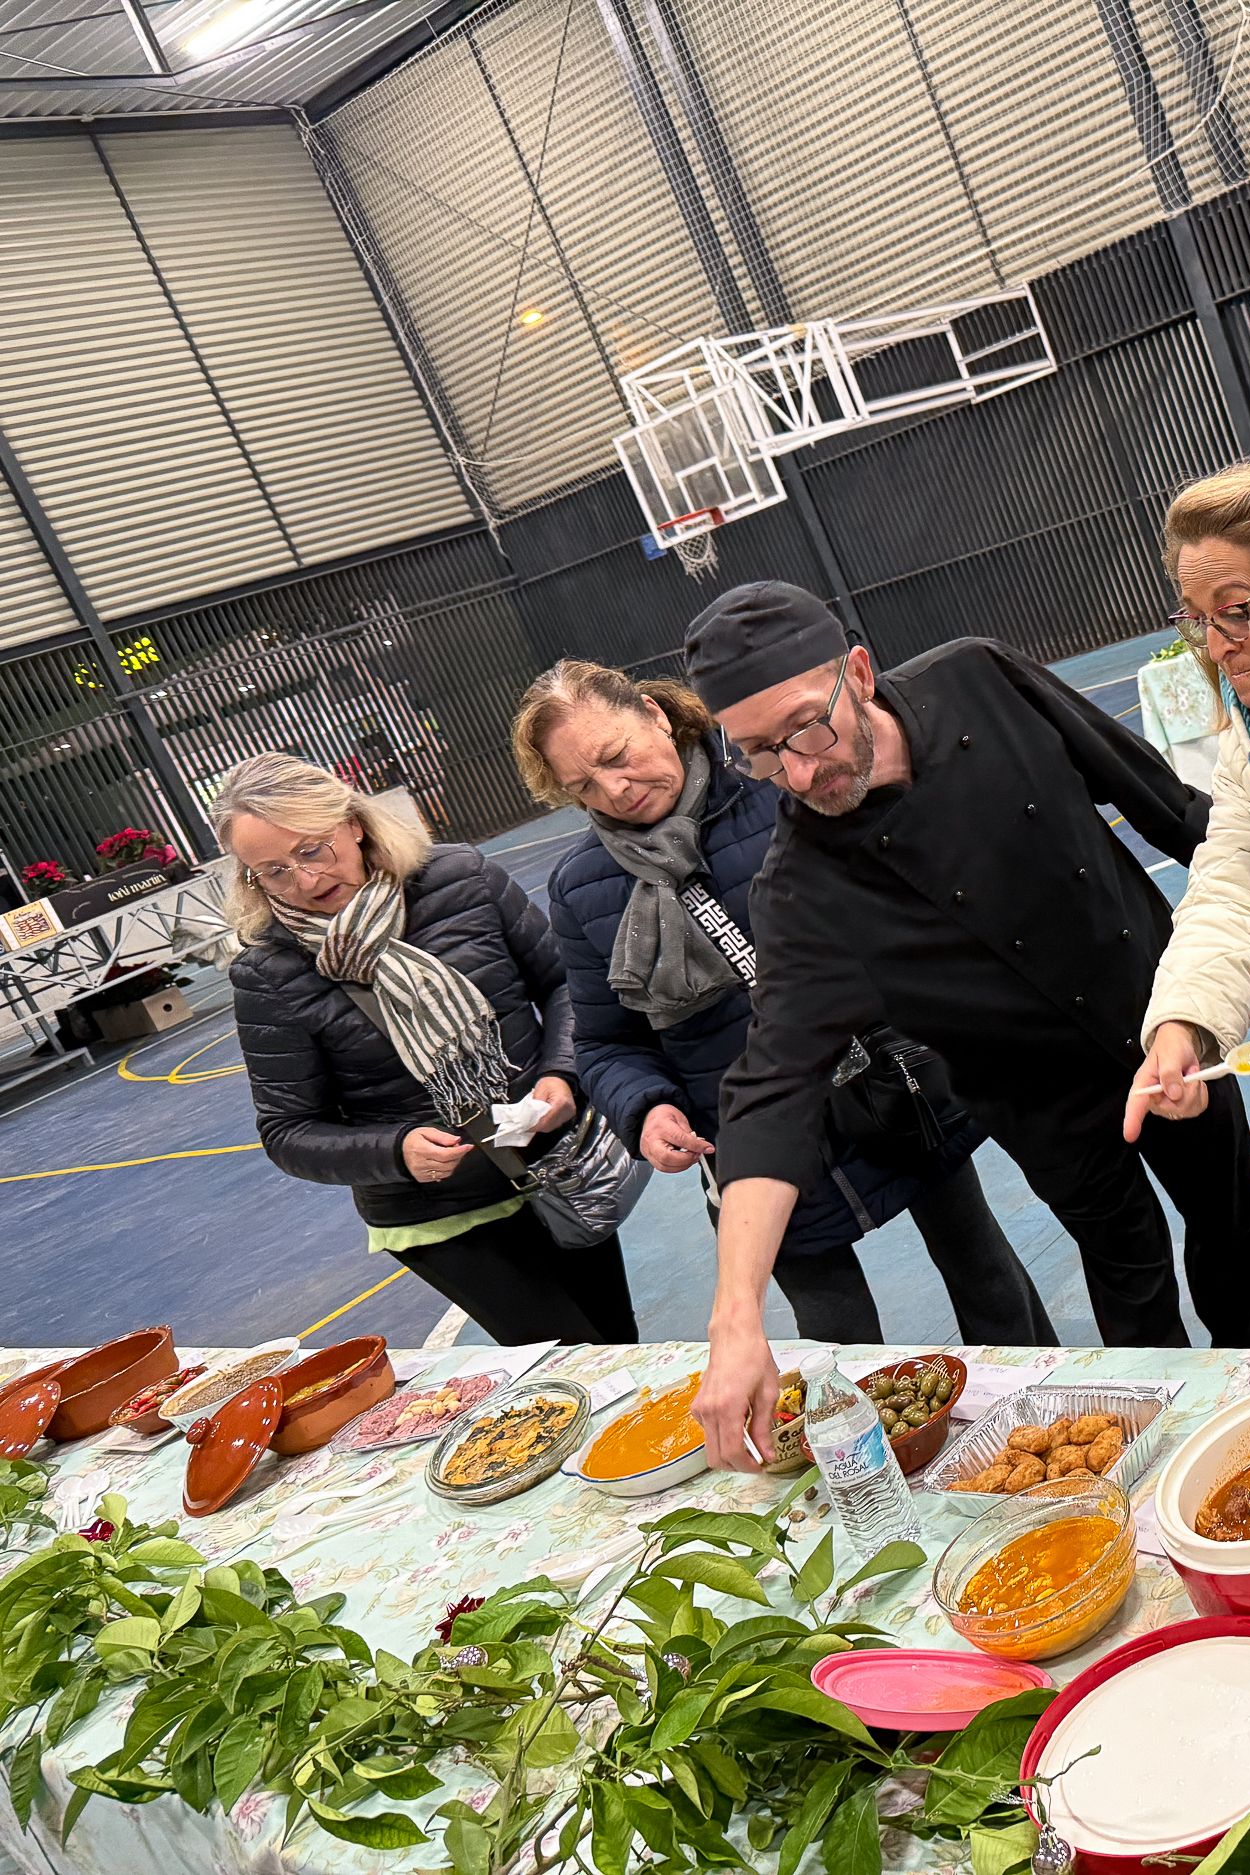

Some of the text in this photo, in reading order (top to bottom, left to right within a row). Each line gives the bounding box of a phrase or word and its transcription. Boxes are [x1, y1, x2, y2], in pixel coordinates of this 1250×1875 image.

[829, 1463, 869, 1480] DEL ROSAL
[834, 1459, 858, 1472] AGUA
